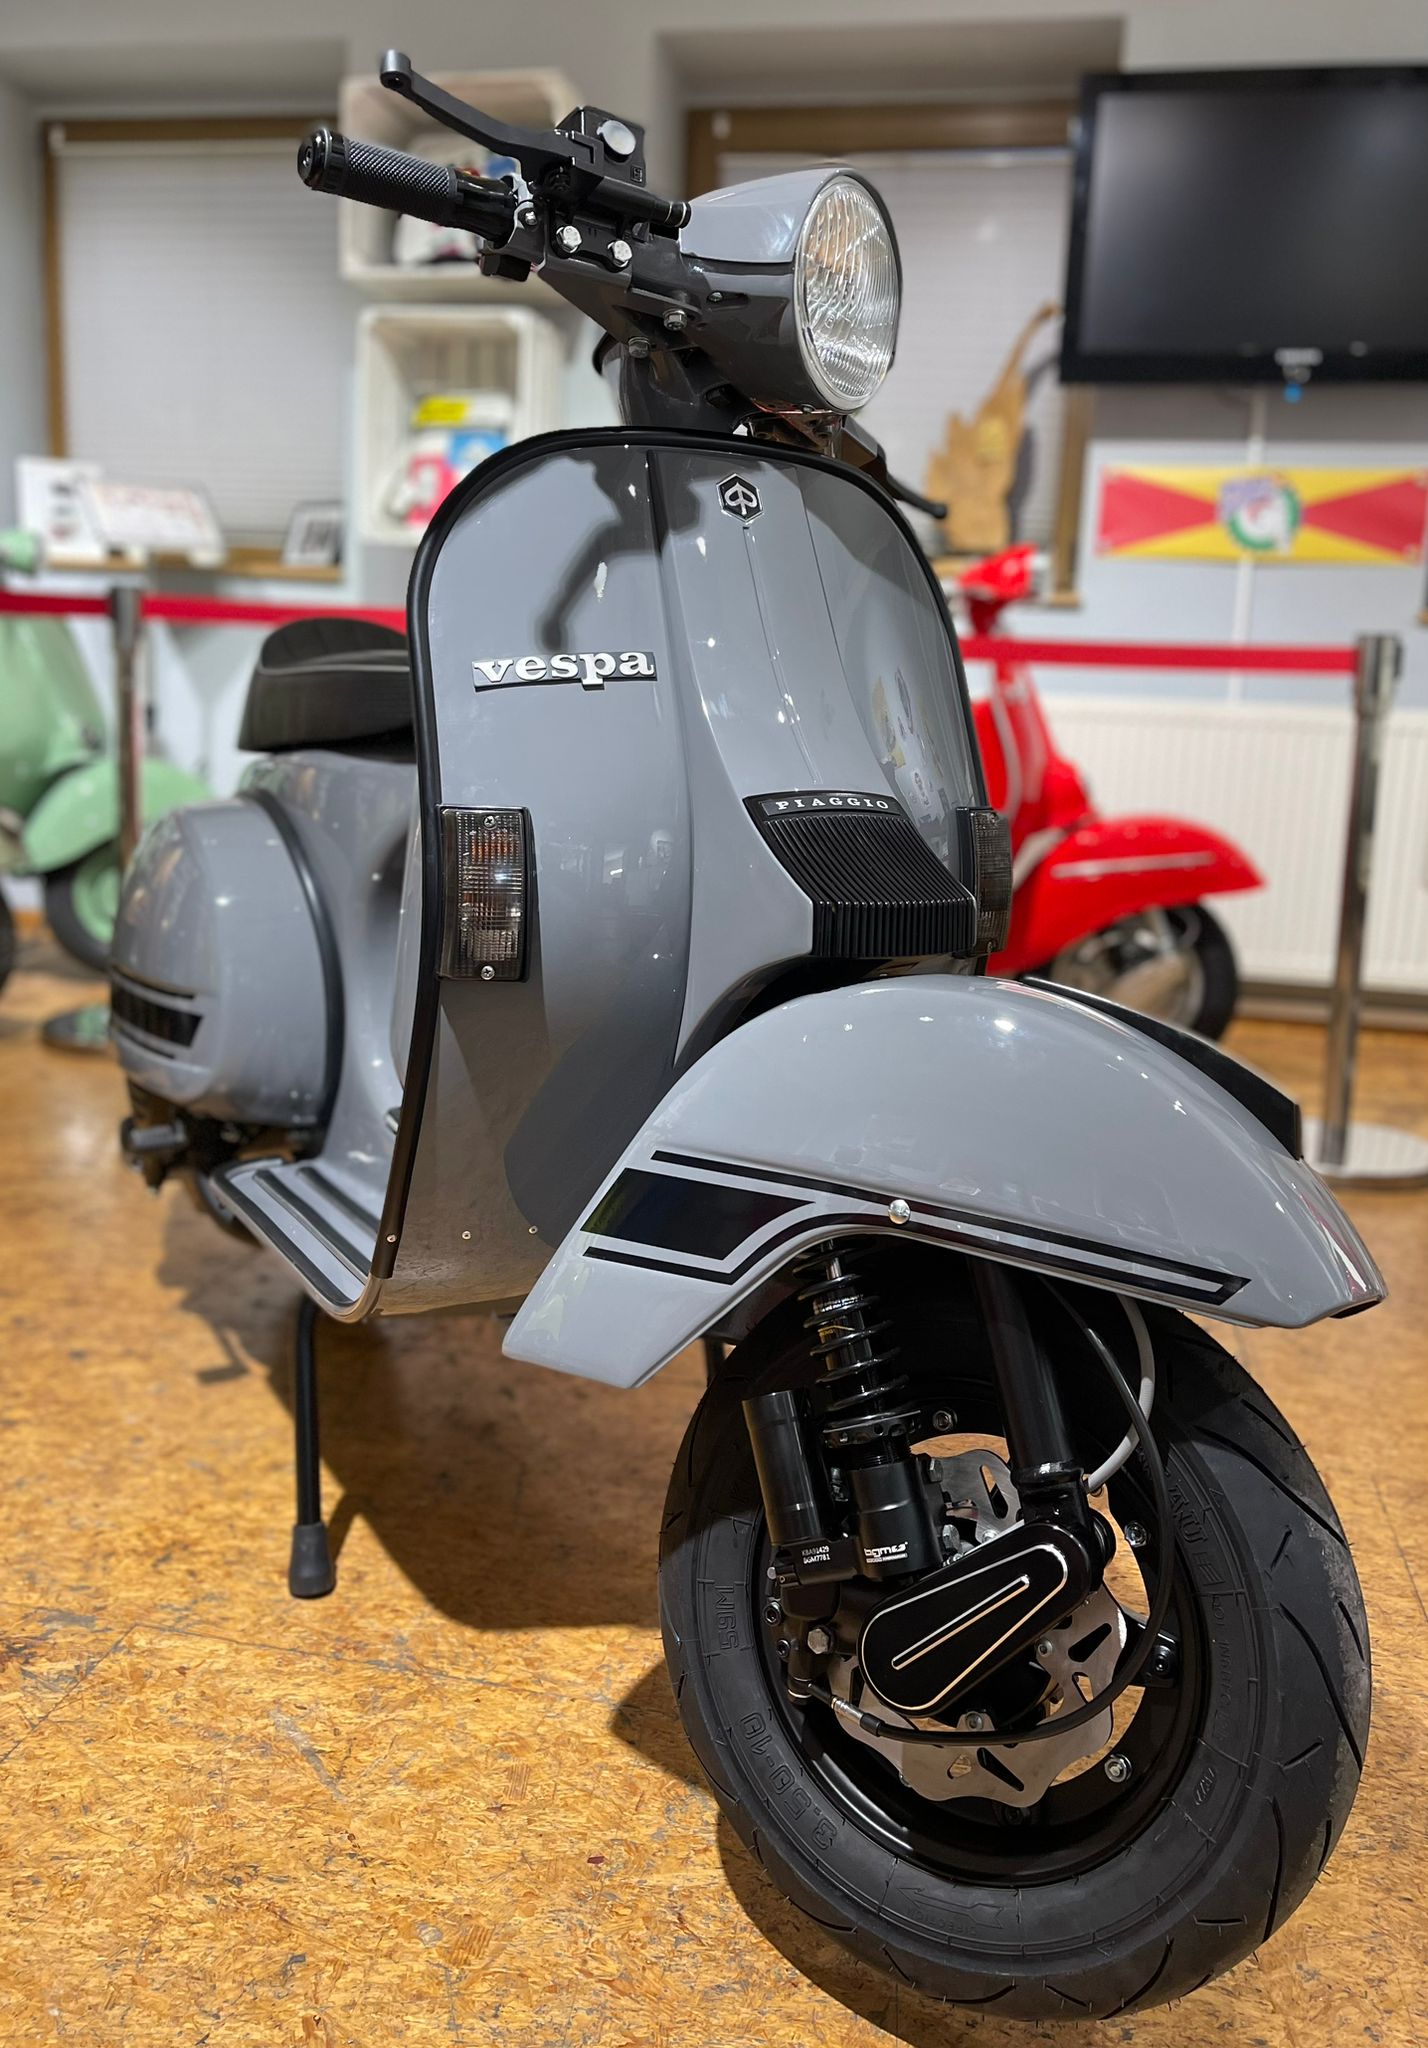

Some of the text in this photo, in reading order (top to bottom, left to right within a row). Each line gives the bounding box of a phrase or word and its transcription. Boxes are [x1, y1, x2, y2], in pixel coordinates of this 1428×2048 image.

[473, 651, 655, 686] vespa
[775, 796, 889, 810] PIAGGIO
[712, 1584, 741, 1650] 59M
[738, 1711, 839, 1851] 3.50-10
